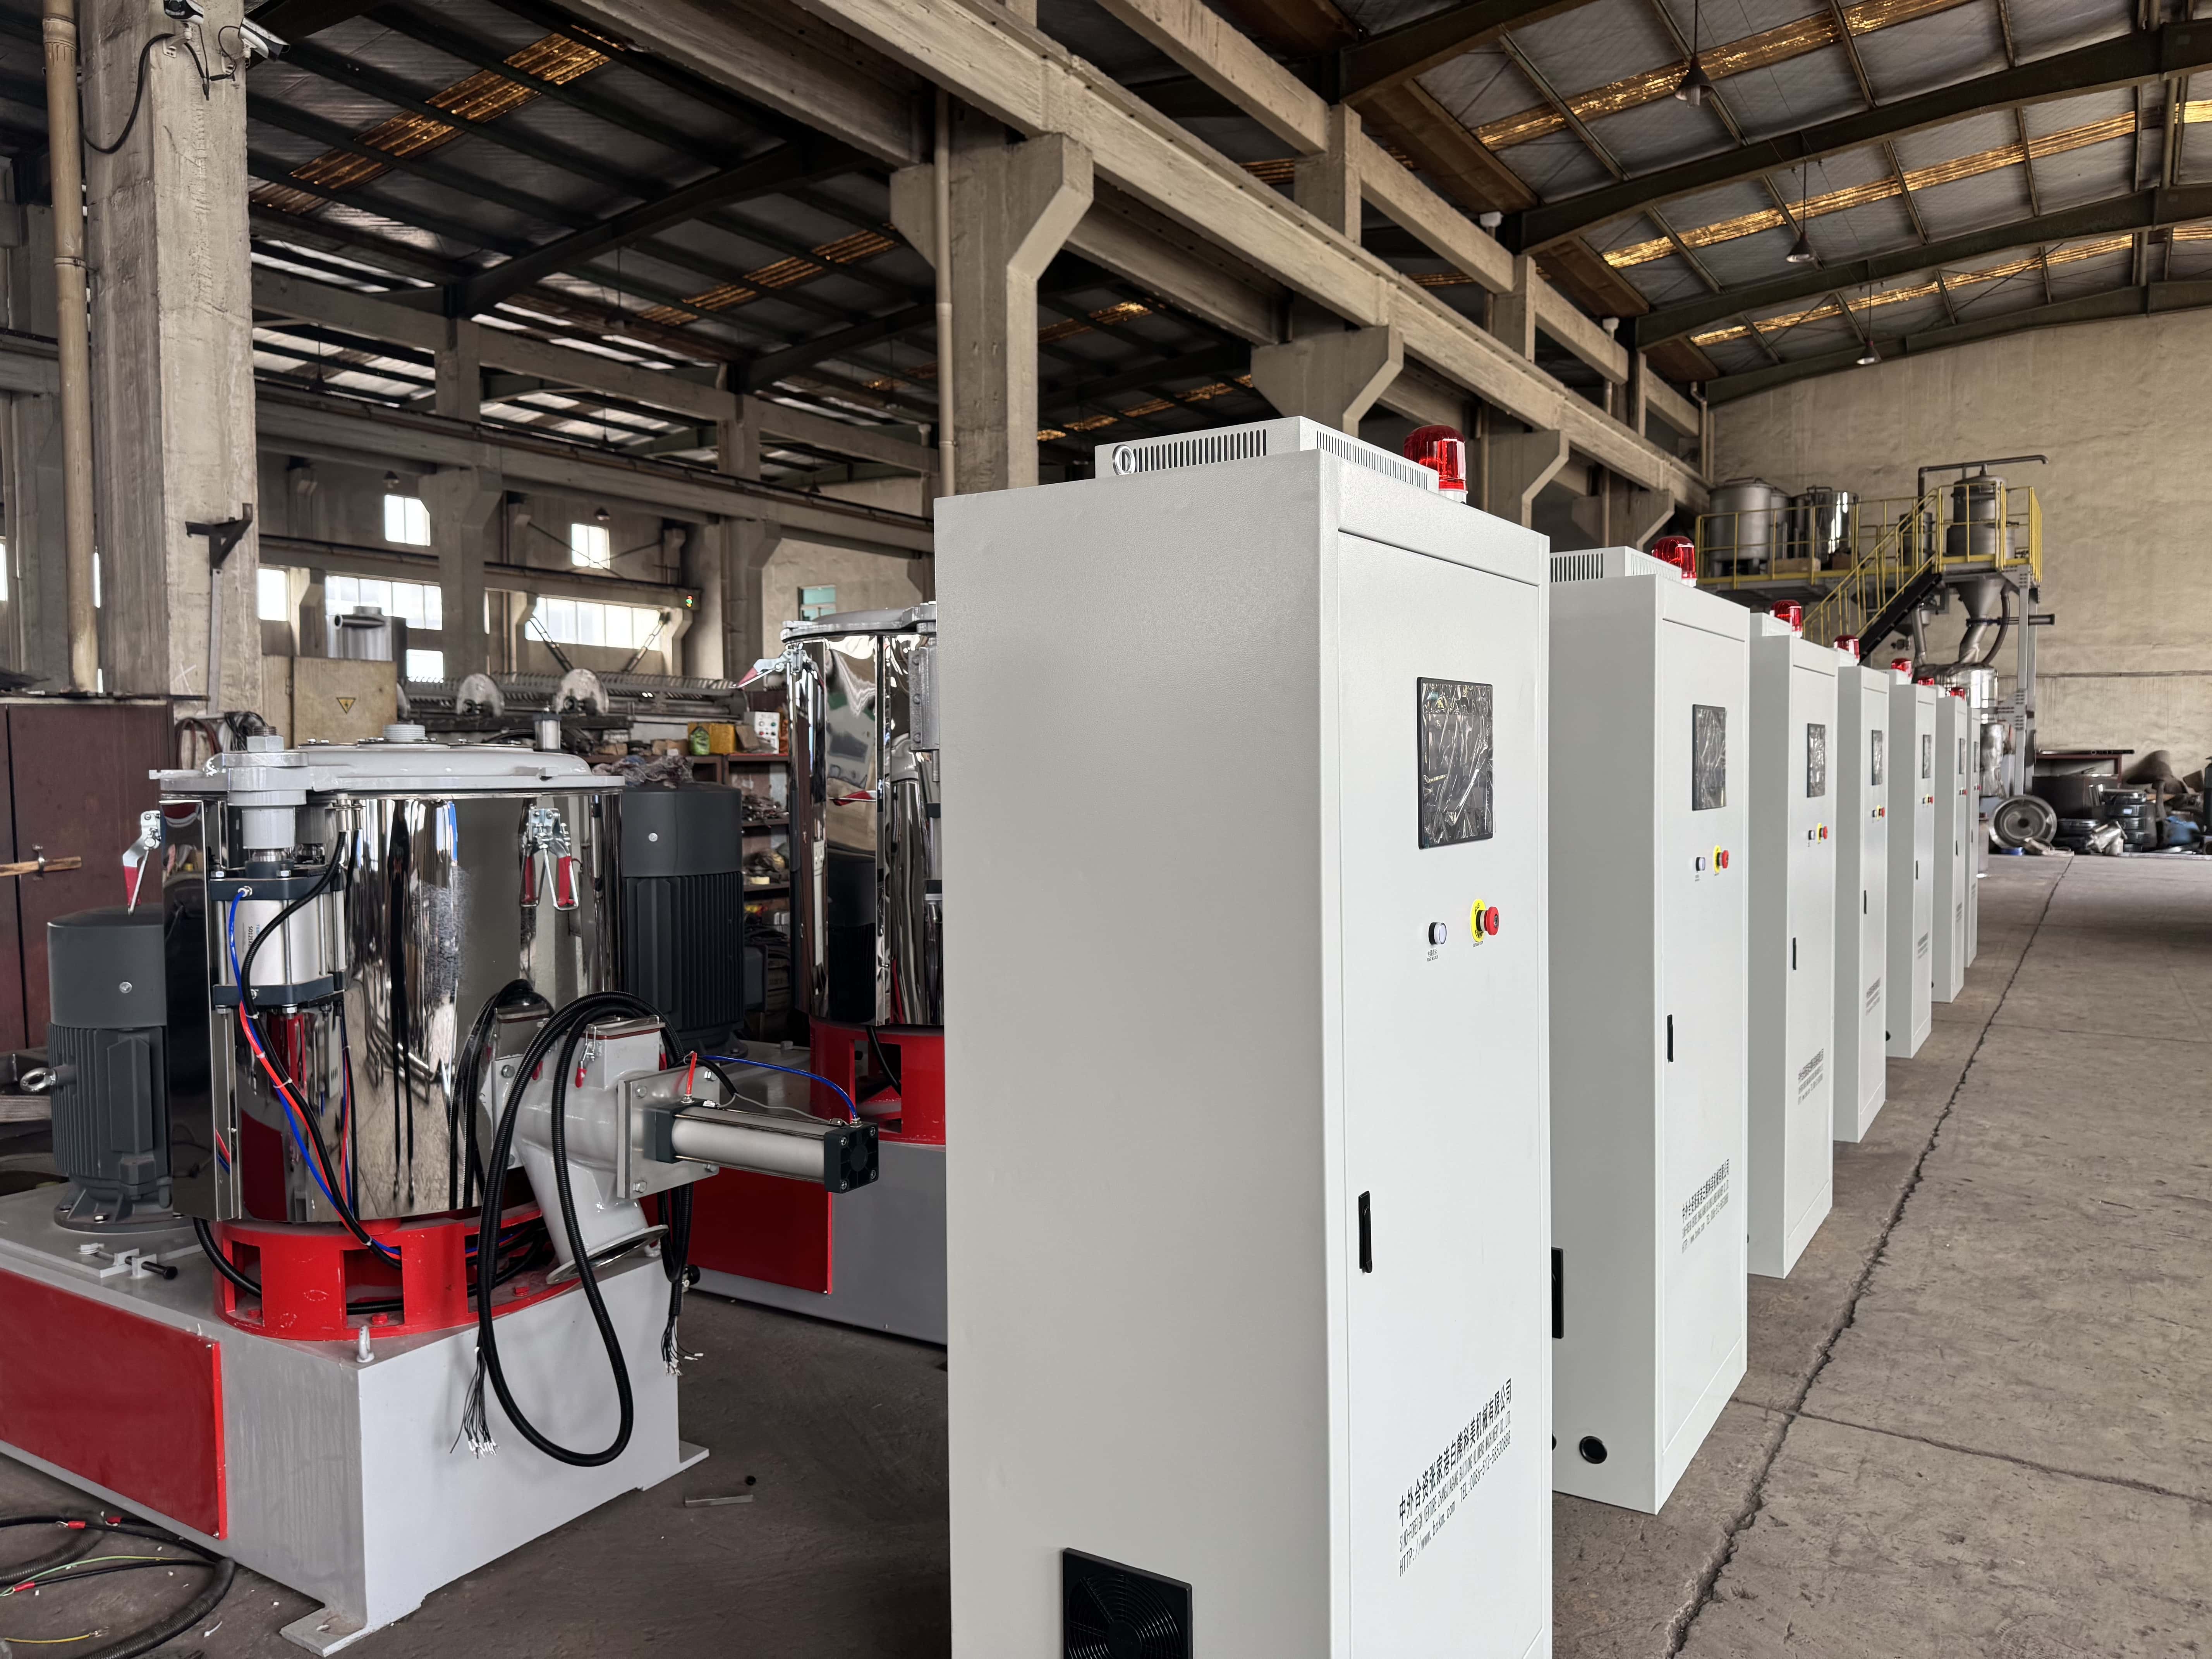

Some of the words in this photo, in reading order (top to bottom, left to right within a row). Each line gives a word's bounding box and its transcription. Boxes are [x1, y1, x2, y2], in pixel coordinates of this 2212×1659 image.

[1399, 1378, 1511, 1527] 中外合资张家港白熊科美机械有限公司
[1400, 1511, 1422, 1552] SINO-FOREIGN
[1424, 1494, 1437, 1524] VENTURE
[1438, 1470, 1458, 1508] ZHANGJIAGANG
